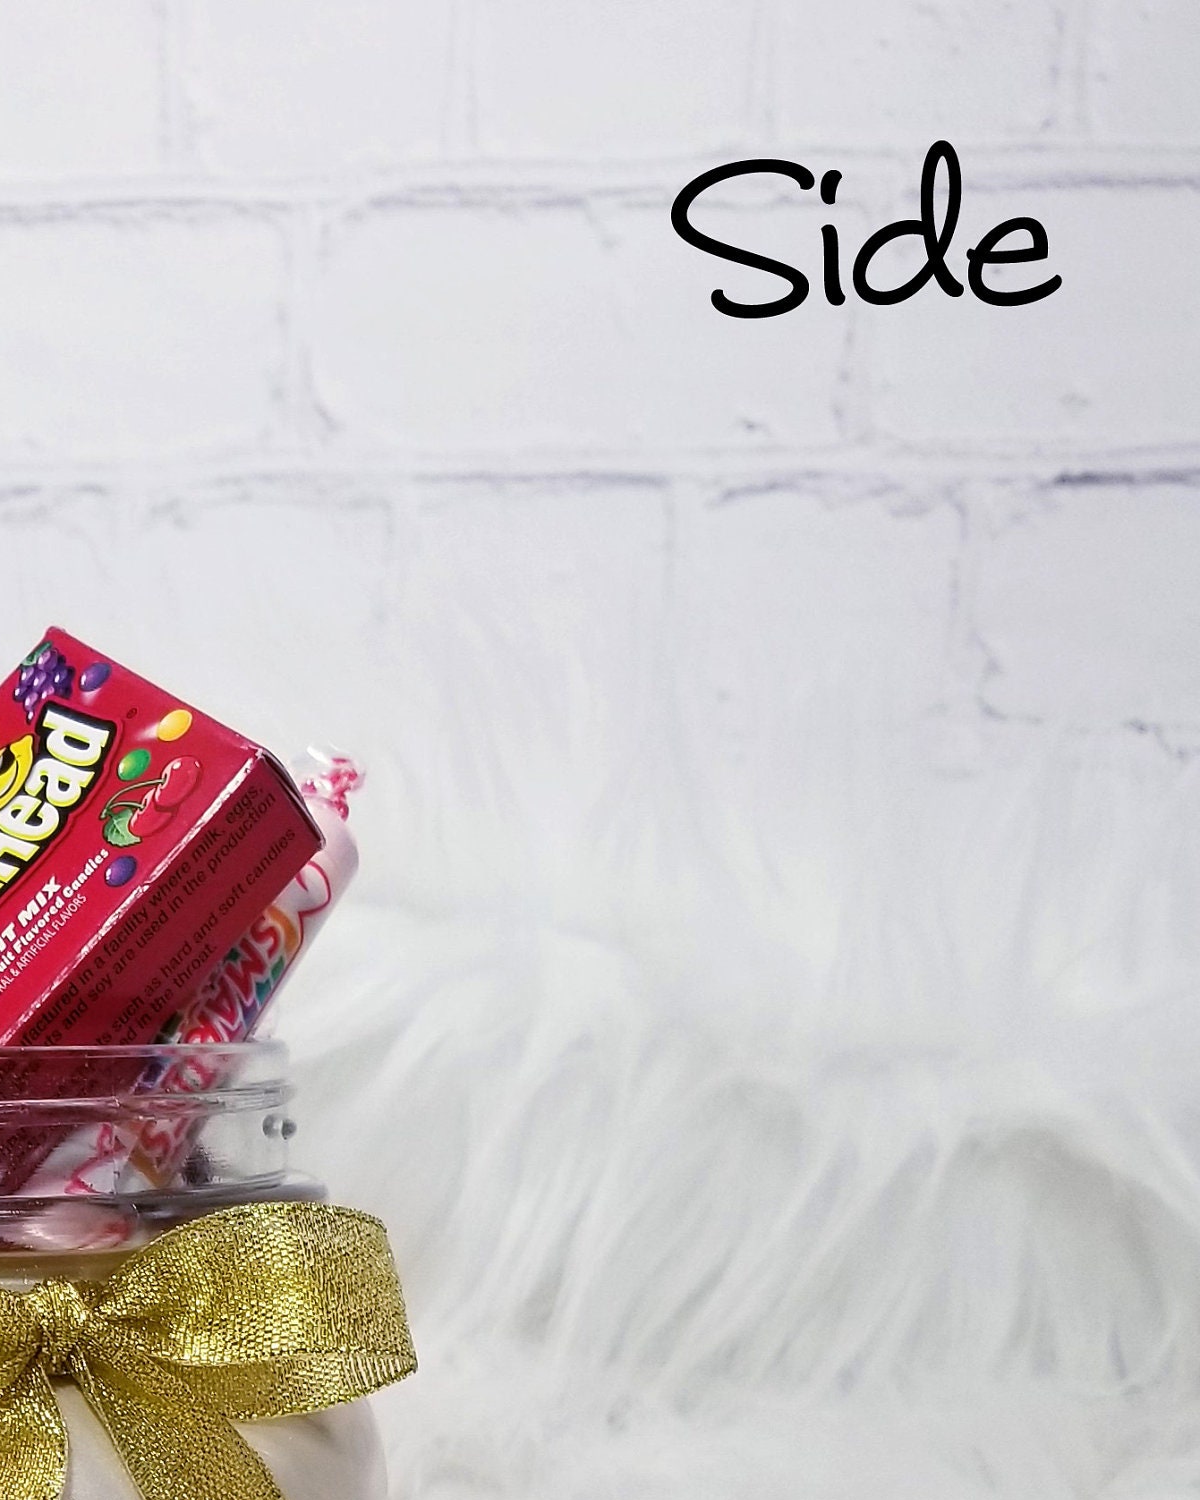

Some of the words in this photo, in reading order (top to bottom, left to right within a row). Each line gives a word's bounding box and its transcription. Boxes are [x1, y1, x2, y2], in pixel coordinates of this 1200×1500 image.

[13, 899, 66, 953] Flavored
[63, 848, 109, 899] Candies
[17, 875, 62, 928] MIX
[17, 931, 58, 972] ARTIFICIAL
[55, 893, 87, 933] FLAVORS
[61, 1001, 90, 1031] and
[87, 974, 113, 1006] soy
[114, 954, 136, 979] are
[135, 919, 169, 955] used
[168, 895, 182, 915] in
[182, 871, 208, 901] the
[206, 791, 277, 876] production
[78, 968, 94, 990] in
[95, 958, 106, 971] a
[102, 905, 150, 958] facility
[149, 862, 192, 907] where
[112, 995, 145, 1034] such
[146, 981, 161, 1000] as
[160, 944, 192, 979] hard
[191, 915, 220, 947] and
[217, 884, 246, 917] soft
[245, 828, 297, 887] candies
[136, 1013, 154, 1034] in
[150, 987, 176, 1015] the
